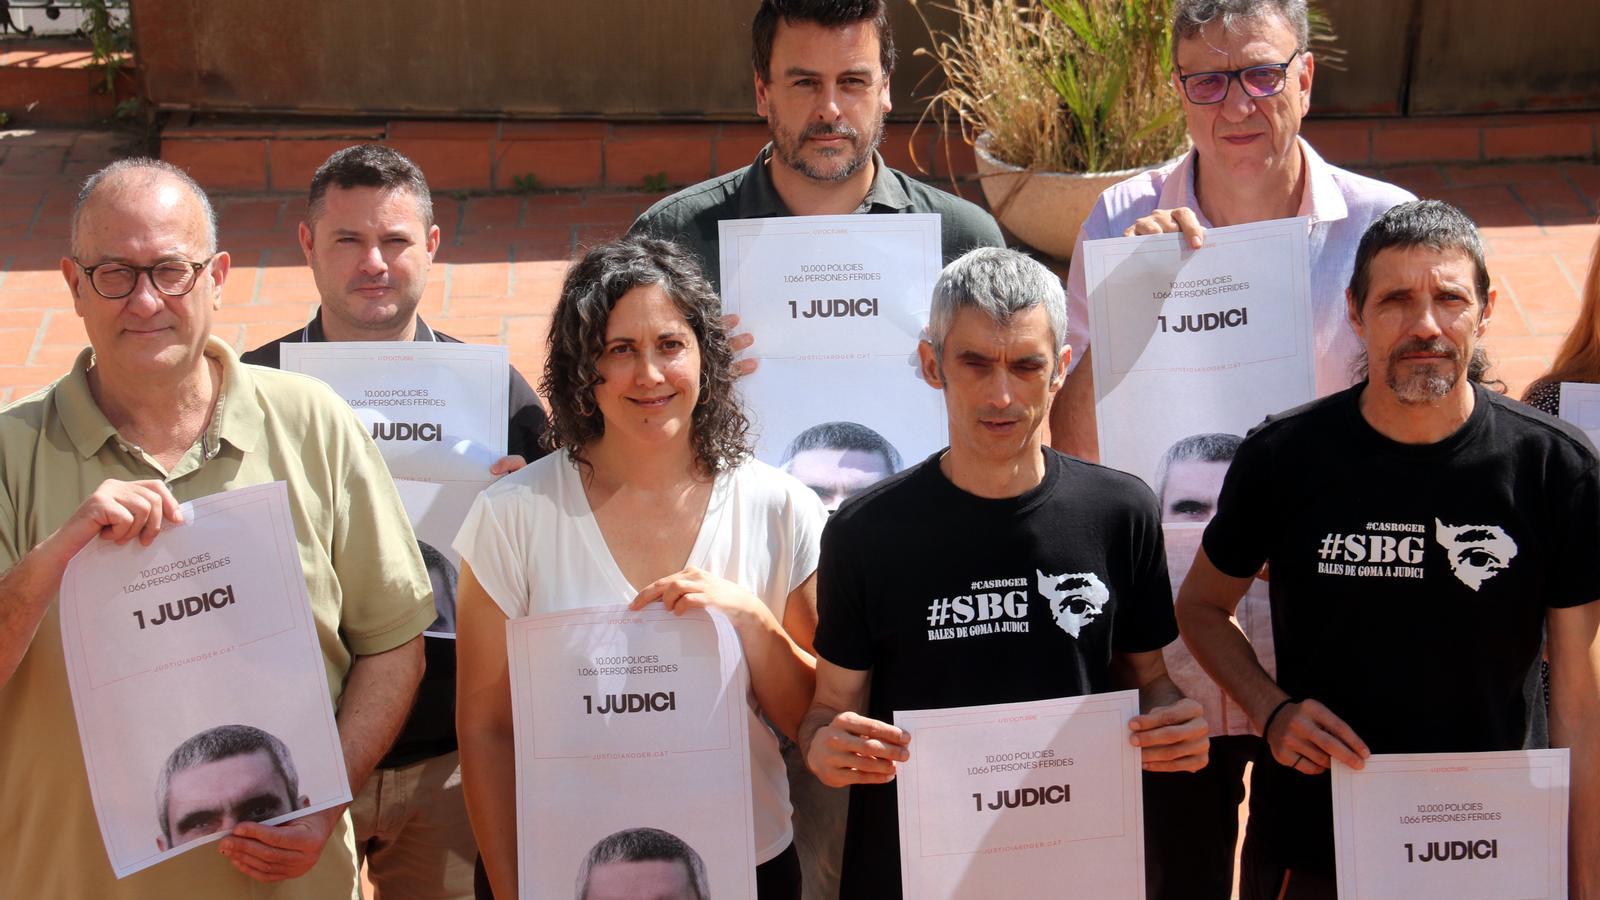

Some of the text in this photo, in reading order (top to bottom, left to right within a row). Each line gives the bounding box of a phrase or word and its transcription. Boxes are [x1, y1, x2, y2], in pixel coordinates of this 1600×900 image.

[784, 275, 804, 283] 1.066
[805, 273, 848, 282] PERSONES
[1170, 275, 1232, 289] 10.000 POLICIES
[1153, 282, 1249, 299] 1.066 PERSONES FERIDES
[789, 298, 878, 318] 1 JUDICI
[1158, 308, 1247, 332] 1 JUDICI
[392, 389, 428, 397] POLICIES
[369, 399, 412, 407] PERSONES
[372, 423, 441, 441] JUDICI
[1366, 522, 1425, 533] #CASROGER
[1318, 533, 1424, 564] #SBG
[140, 553, 210, 578] 10.000 POLICIES
[1318, 562, 1424, 578] BALES DE GOMA A JUDICI
[123, 557, 230, 593] 1.066 PERSONES FERIDES
[971, 578, 1027, 590] #CASROGER
[133, 585, 235, 629] 1 JUDICI
[927, 591, 1028, 626] #SBG
[928, 622, 1029, 640] BALES DE GOMA A JUDICI
[623, 655, 658, 664] POLICIES
[578, 665, 678, 676] 1.066 PERSONES FERIDES
[584, 692, 675, 714] 1 JUDICI
[985, 750, 1054, 763] 10.000 POLICIES
[968, 758, 1073, 775] 1.066 PERSONES FERIDES
[972, 784, 1070, 811] 1 JUDICI
[1417, 803, 1483, 813] 10.000 POLICIES
[1400, 813, 1501, 824] 1.066 PERSONES FERIDES
[1404, 840, 1497, 862] 1 JUDICI
